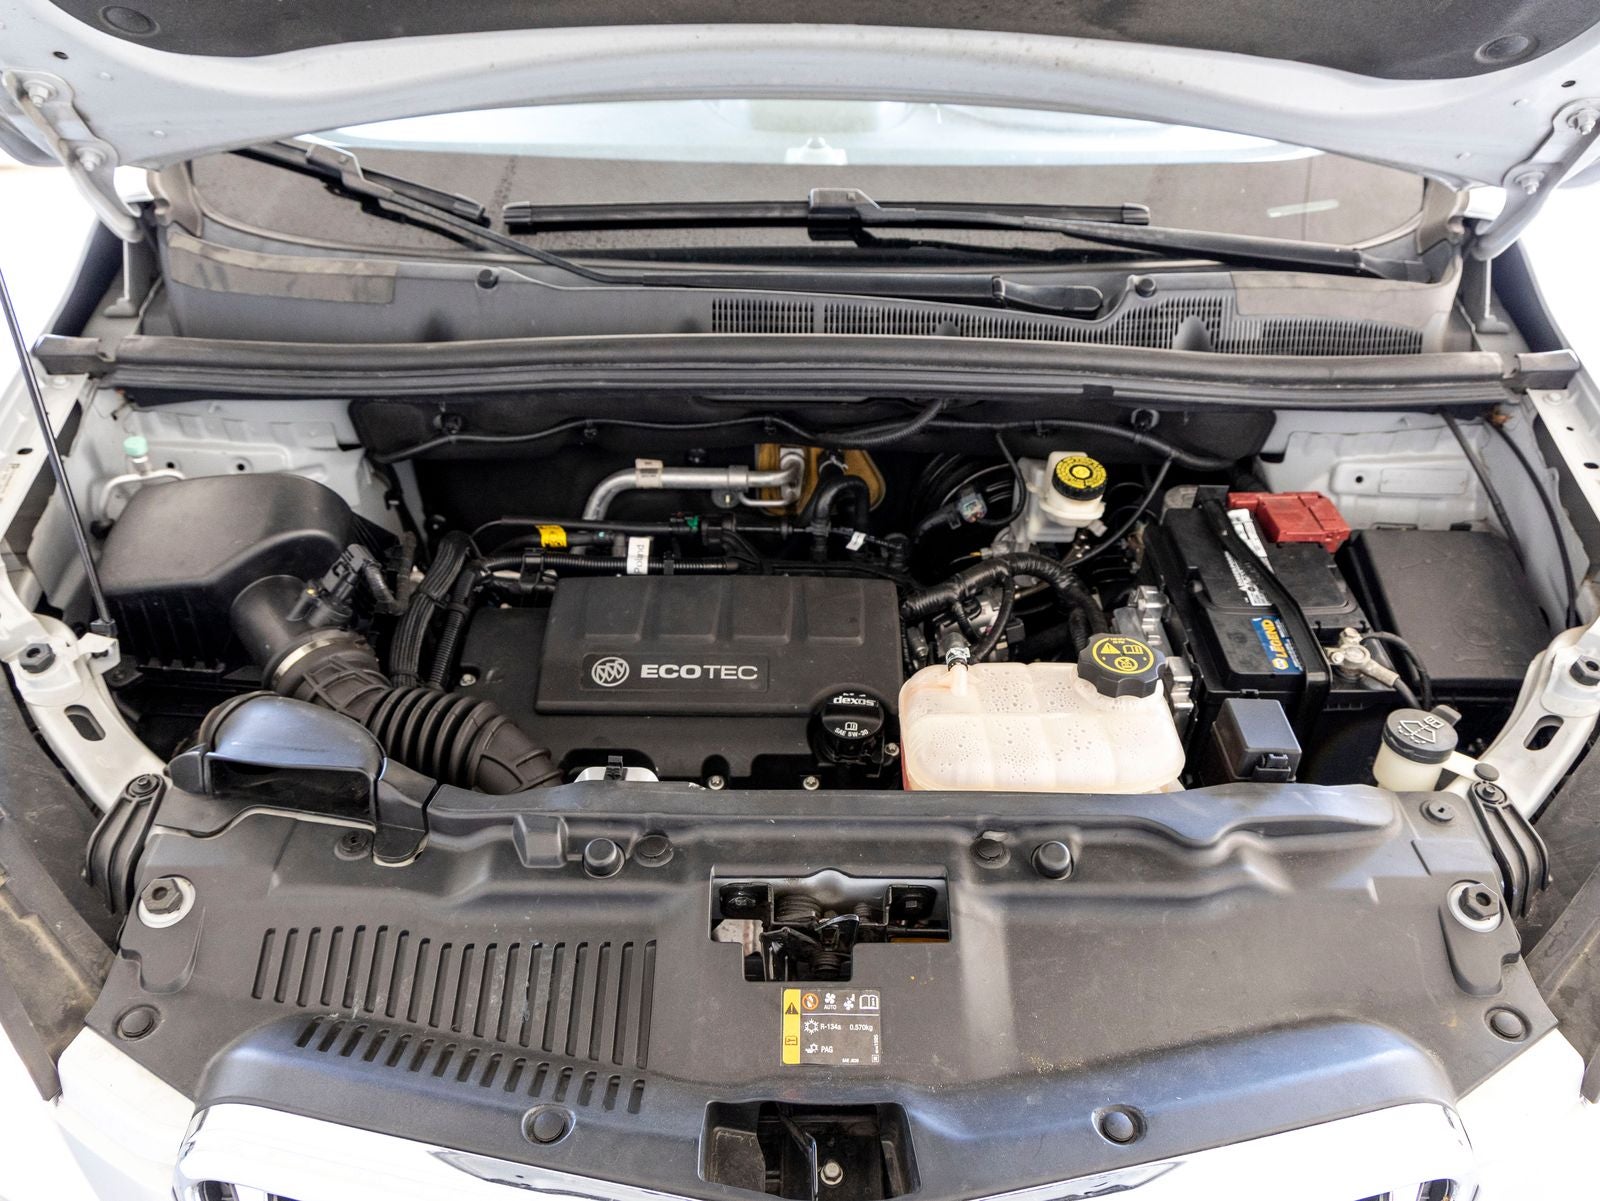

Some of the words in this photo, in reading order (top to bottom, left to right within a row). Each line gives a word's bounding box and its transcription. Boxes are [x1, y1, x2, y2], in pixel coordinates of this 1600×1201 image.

[1261, 619, 1289, 658] LEGEND
[640, 664, 758, 680] ECOTEC
[833, 695, 875, 706] dexos
[820, 1045, 834, 1053] PAG
